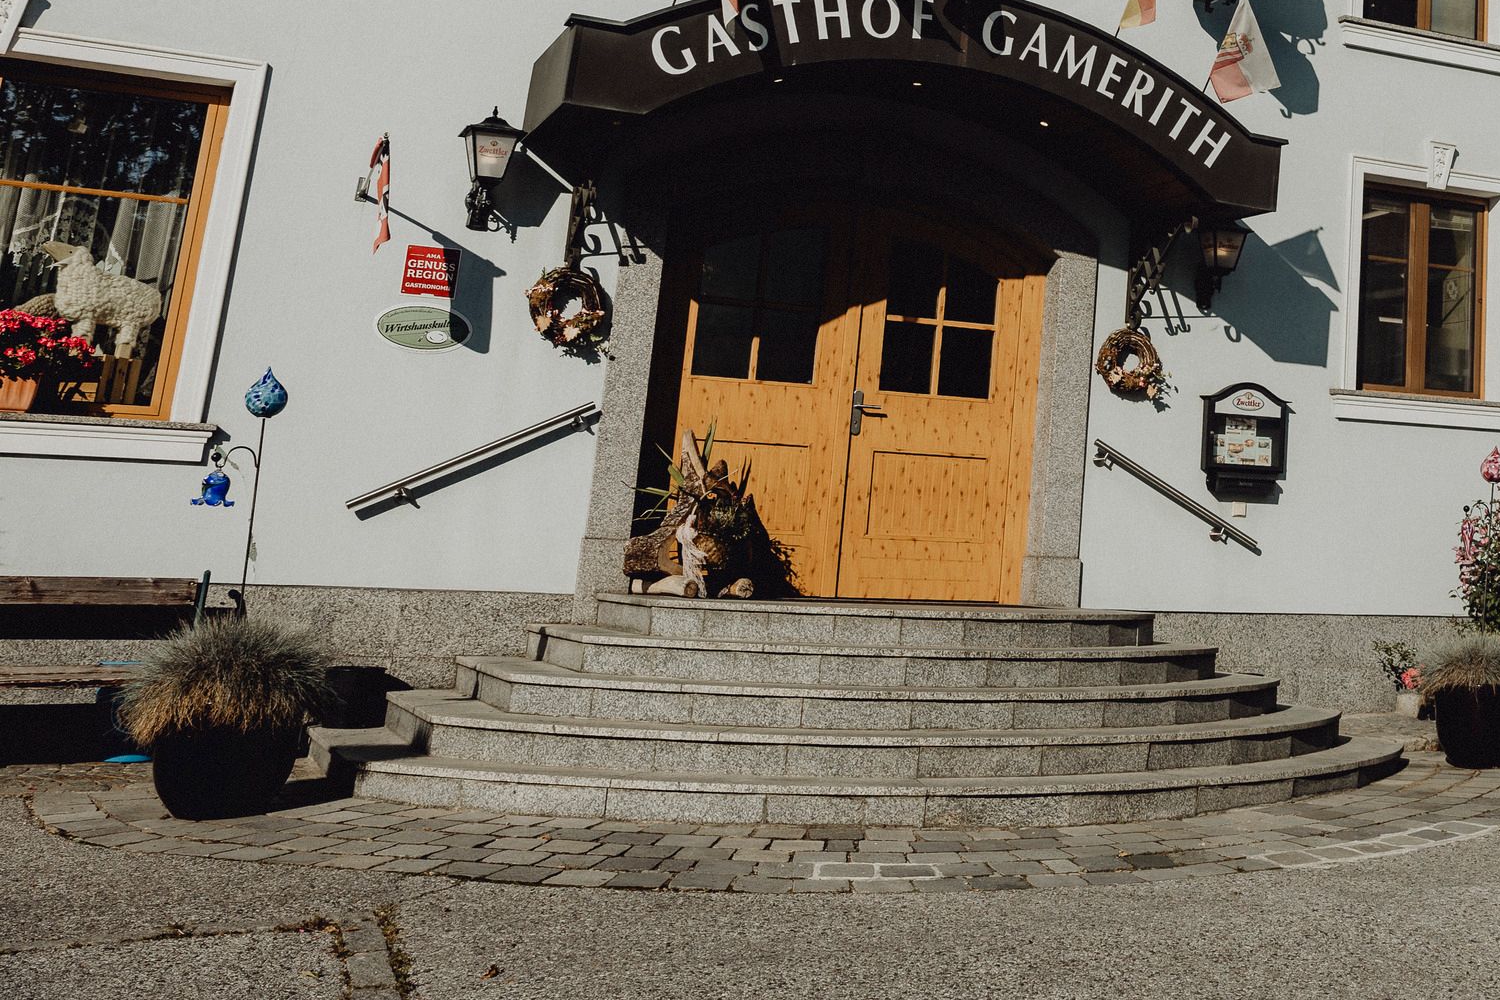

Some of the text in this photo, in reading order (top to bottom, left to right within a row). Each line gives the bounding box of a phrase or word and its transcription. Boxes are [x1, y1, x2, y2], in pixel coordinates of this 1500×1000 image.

[982, 10, 1232, 168] GAMERITH
[478, 145, 508, 156] Zwettler
[407, 259, 456, 272] GENUSS
[406, 269, 453, 281] REGION
[1236, 398, 1261, 408] Zwettler
